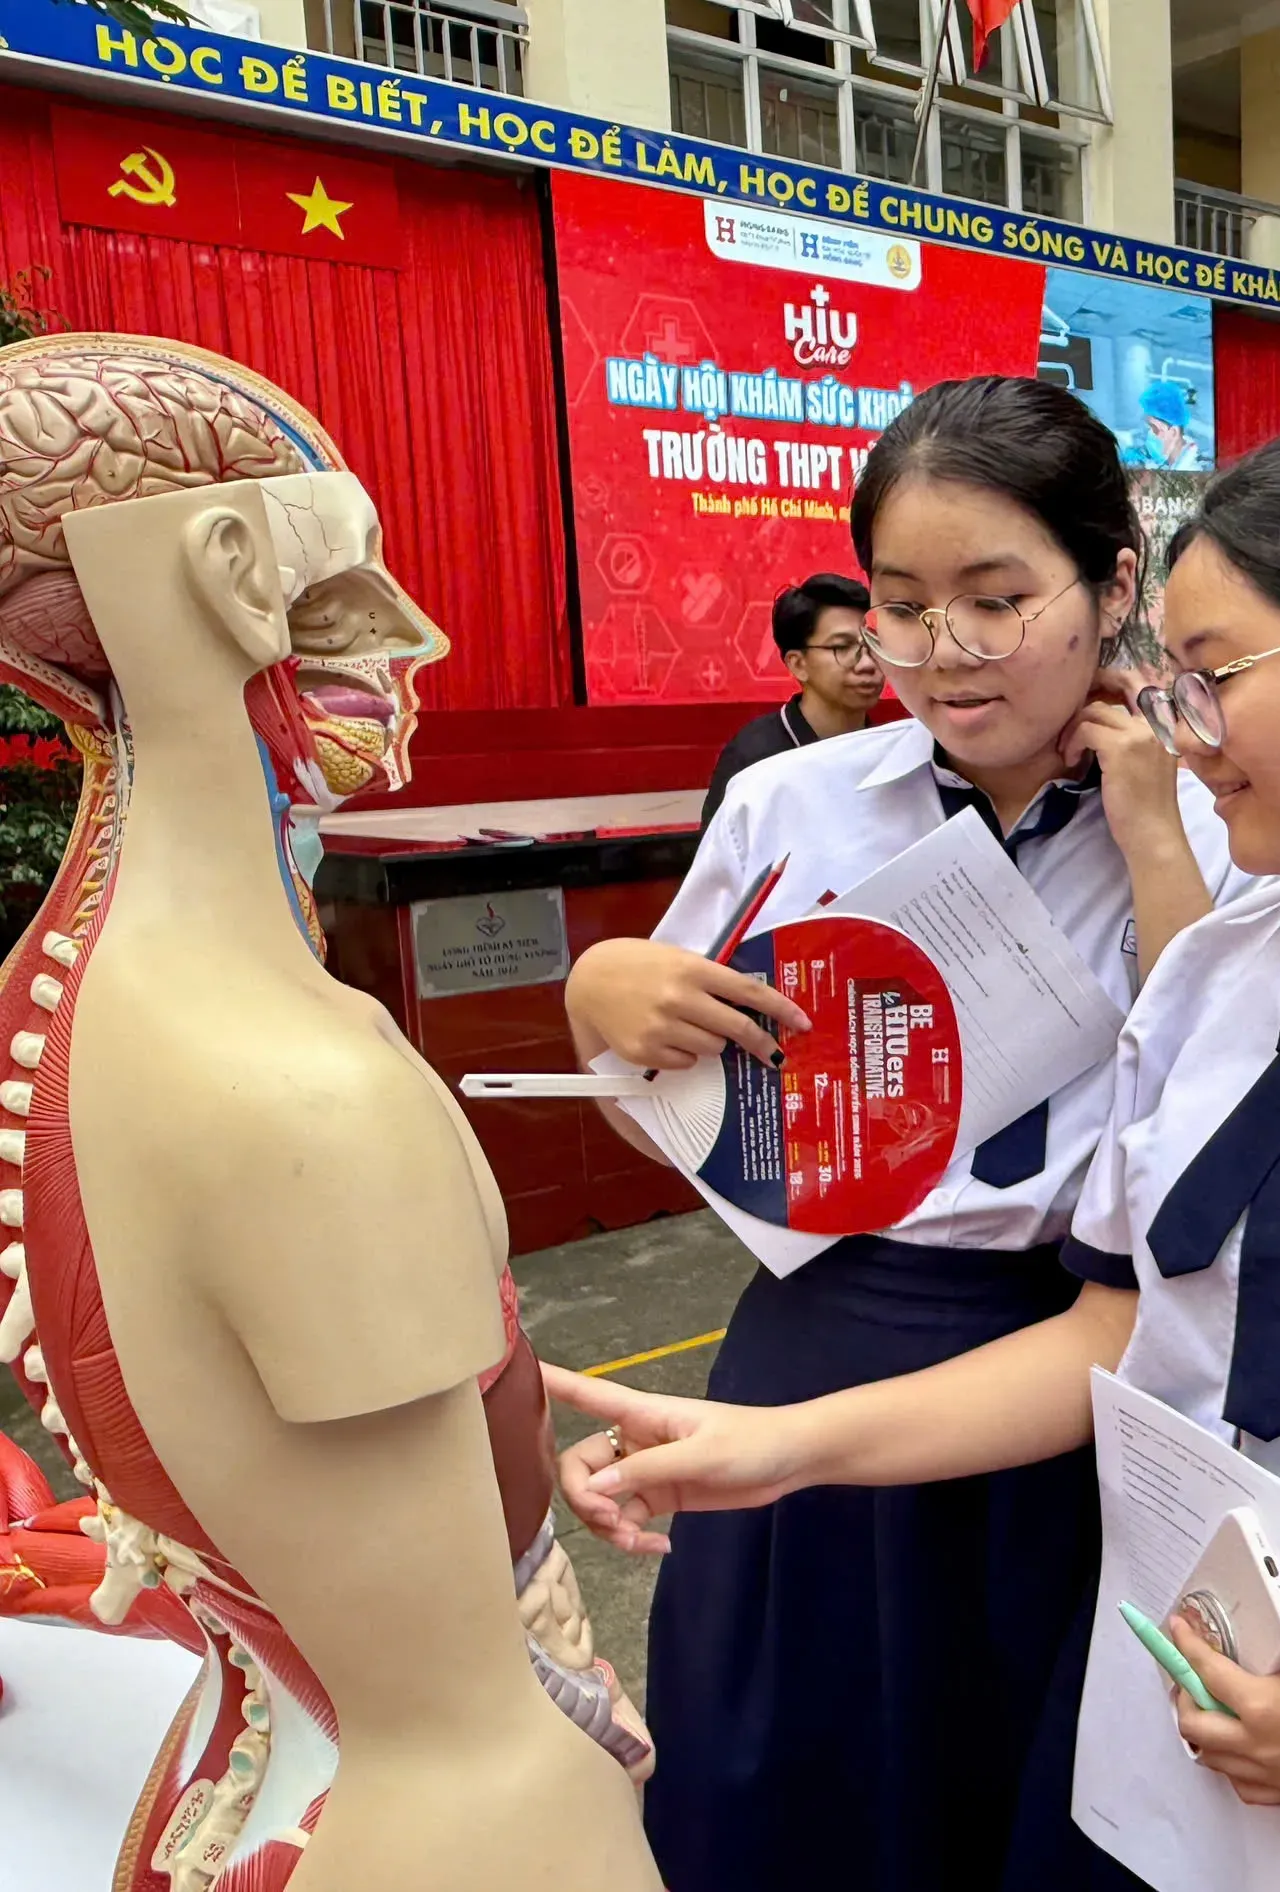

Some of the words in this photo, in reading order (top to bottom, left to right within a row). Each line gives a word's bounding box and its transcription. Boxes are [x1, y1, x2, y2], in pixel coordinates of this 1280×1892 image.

[96, 24, 223, 84] HỌC
[239, 54, 308, 102] ĐỂ
[326, 78, 443, 135] BIẾT,
[458, 103, 556, 153] HỌC
[568, 125, 621, 167] ĐỂ
[636, 141, 727, 193] LÀM,
[740, 164, 816, 207] HỌC
[826, 181, 869, 218] ĐỂ
[880, 197, 994, 243] CHUNG
[1002, 220, 1084, 262] SỐNG
[1091, 240, 1129, 271] VÀ
[1136, 250, 1190, 285] HỌC
[793, 337, 852, 366] Care
[608, 353, 679, 409] NGÀY
[683, 362, 727, 419] HỘI
[730, 369, 805, 421] KHÁM
[806, 376, 854, 426] SỨC
[642, 423, 767, 485] TRƯỜNG
[774, 441, 843, 490] THPT
[692, 493, 731, 517] Thành
[734, 495, 758, 518] phố
[783, 960, 798, 986] 120
[910, 1004, 933, 1029] BE
[862, 993, 884, 1099] TRANSFORMATIVE
[885, 1004, 909, 1098] HIUers
[814, 1072, 829, 1087] 12
[818, 1165, 832, 1182] 30
